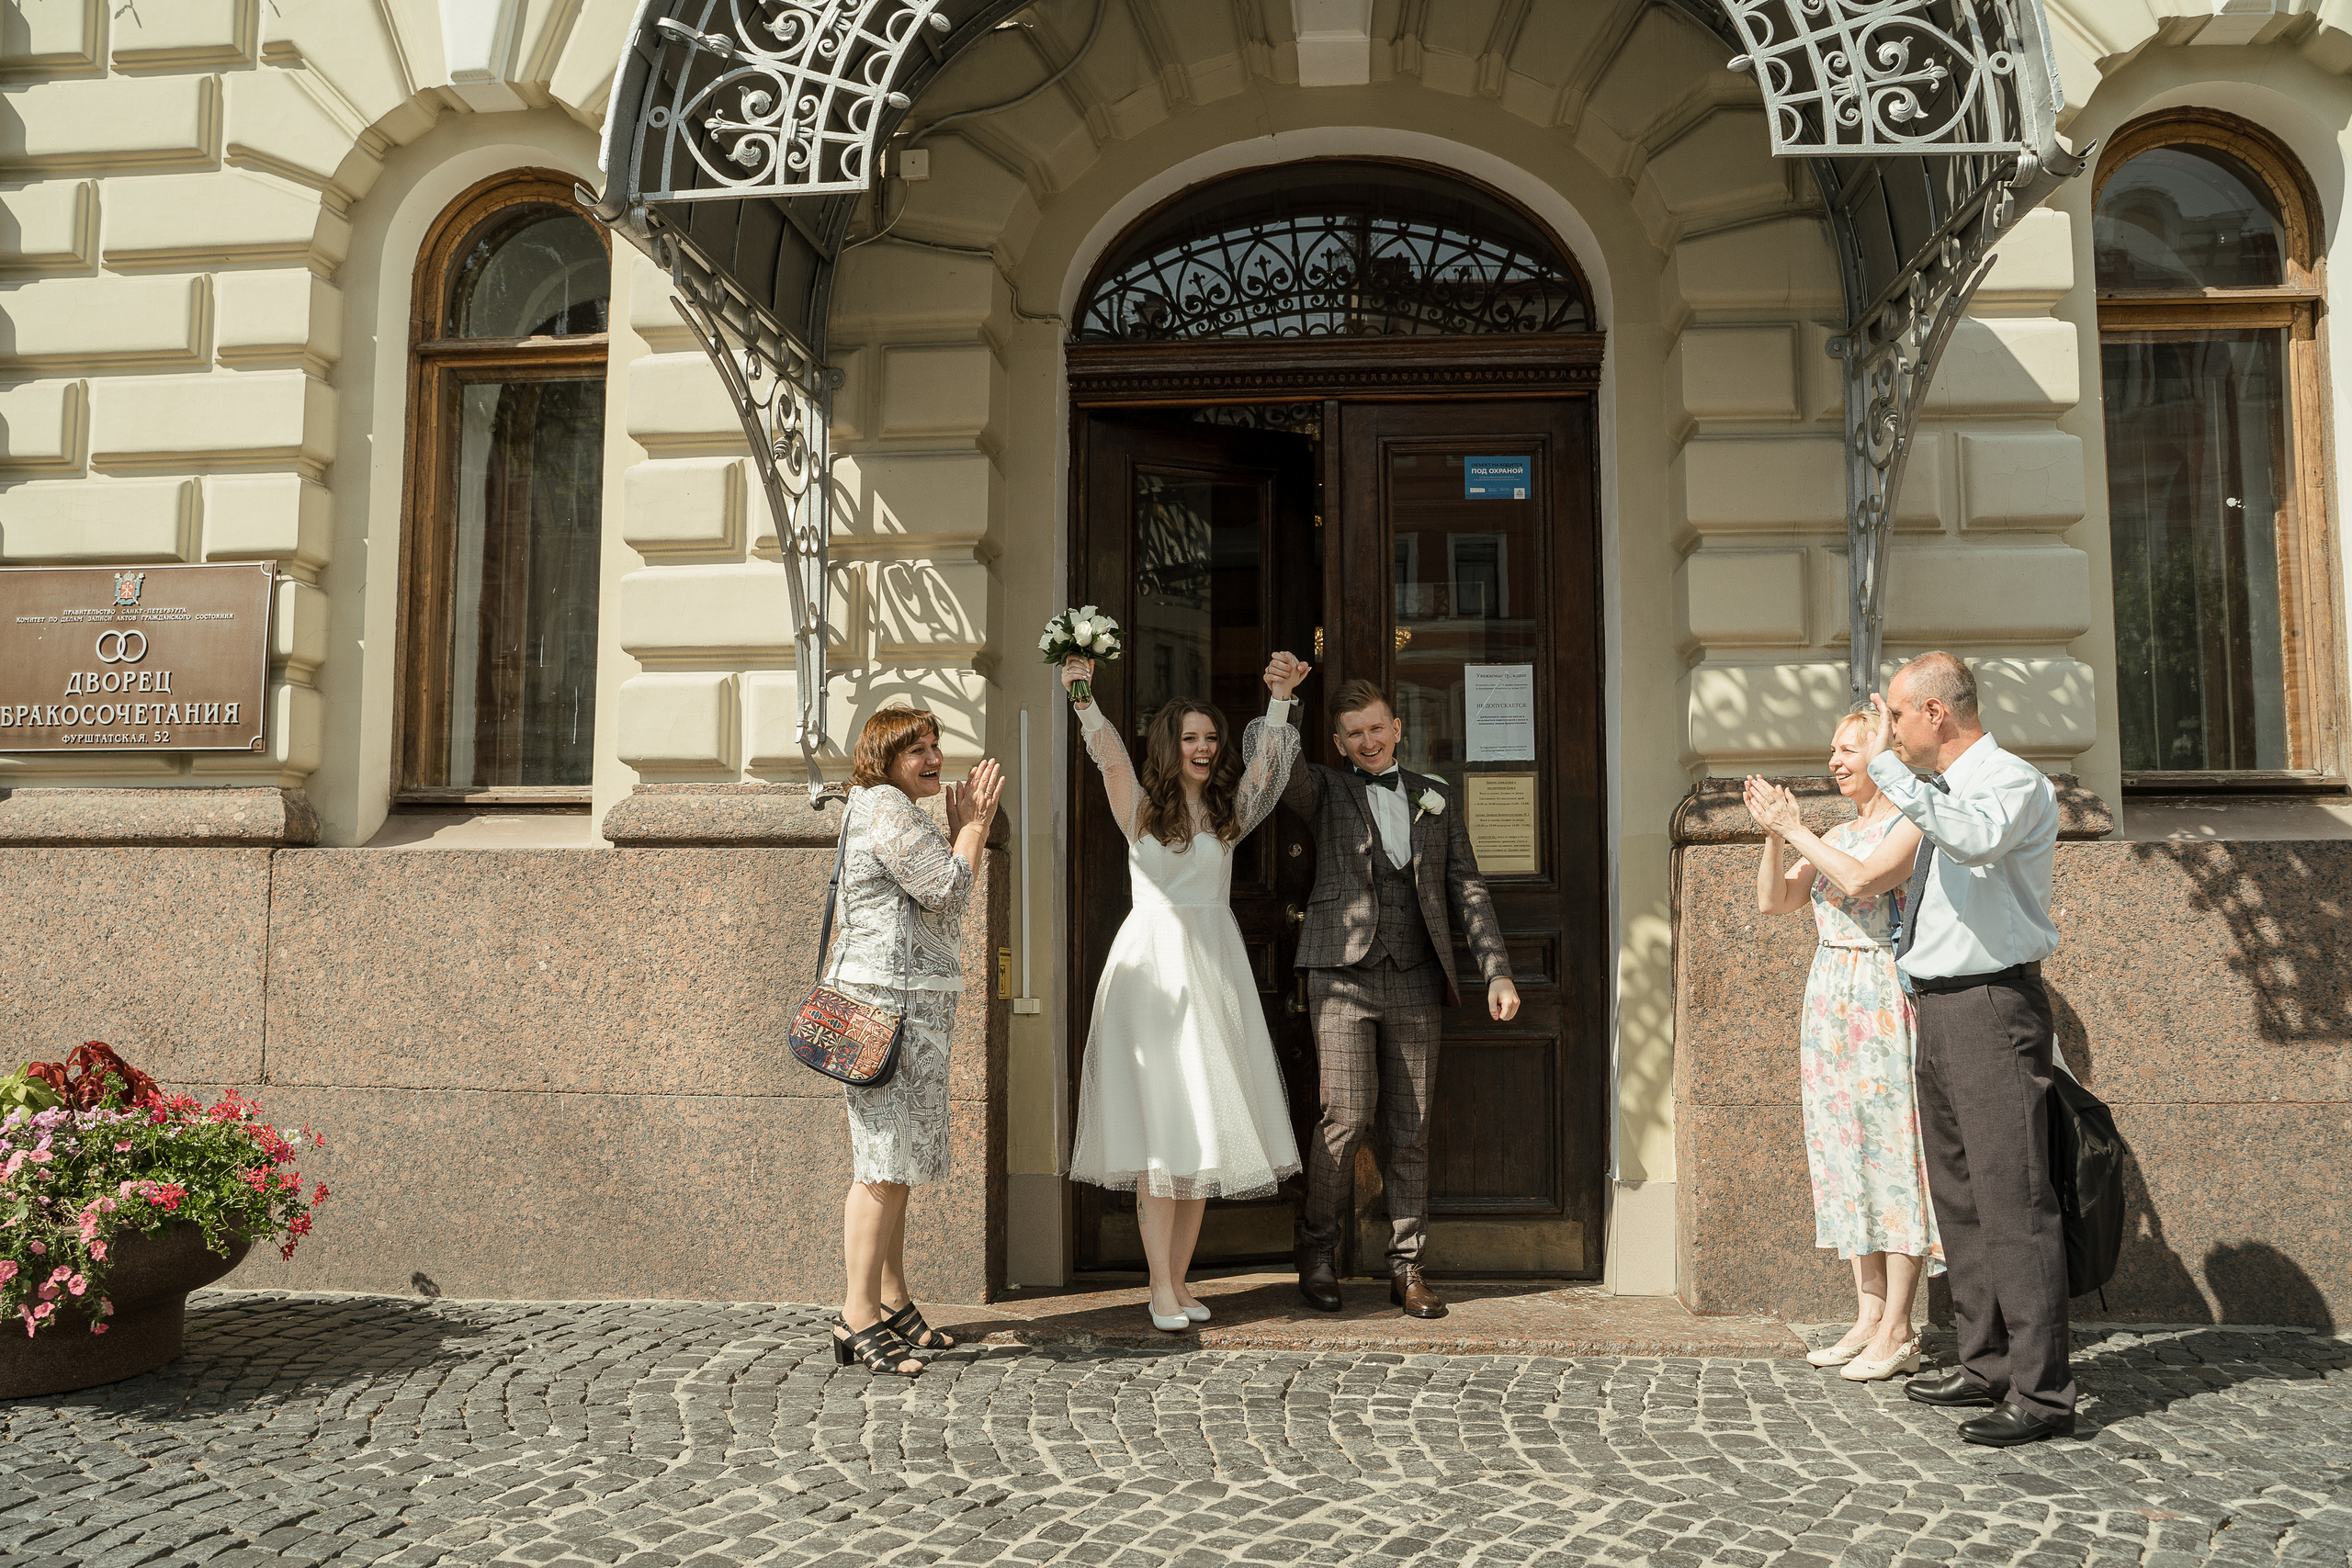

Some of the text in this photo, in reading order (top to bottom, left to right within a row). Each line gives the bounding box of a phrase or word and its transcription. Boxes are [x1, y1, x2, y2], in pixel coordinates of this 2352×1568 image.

[64, 671, 172, 696] ДВОРЕЦ
[0, 702, 240, 728] БРАКОСОЧЕТАНИЯ
[62, 731, 171, 744] ФУРШТАТСКАЯ, 52
